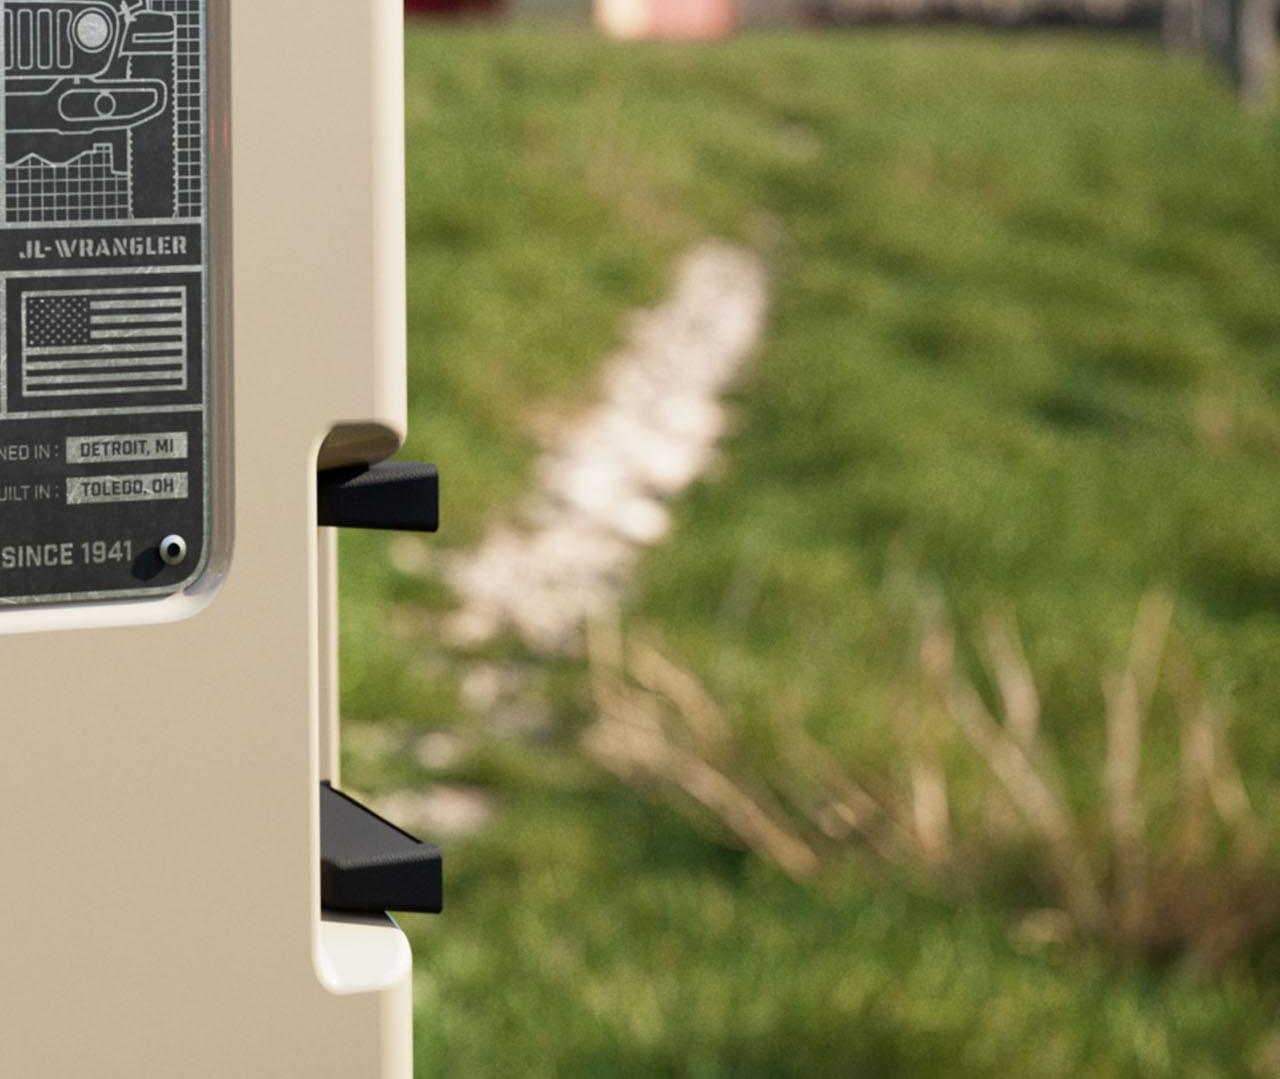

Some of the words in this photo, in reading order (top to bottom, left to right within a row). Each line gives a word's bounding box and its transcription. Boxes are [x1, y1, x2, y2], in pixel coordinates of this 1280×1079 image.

[18, 235, 188, 260] JL-WRANGLER
[79, 438, 151, 458] DETROIT,
[155, 437, 175, 454] MI
[81, 479, 148, 497] TOLEDO,
[151, 477, 175, 494] OH
[0, 542, 74, 569] SINCE
[80, 539, 133, 565] 1941
